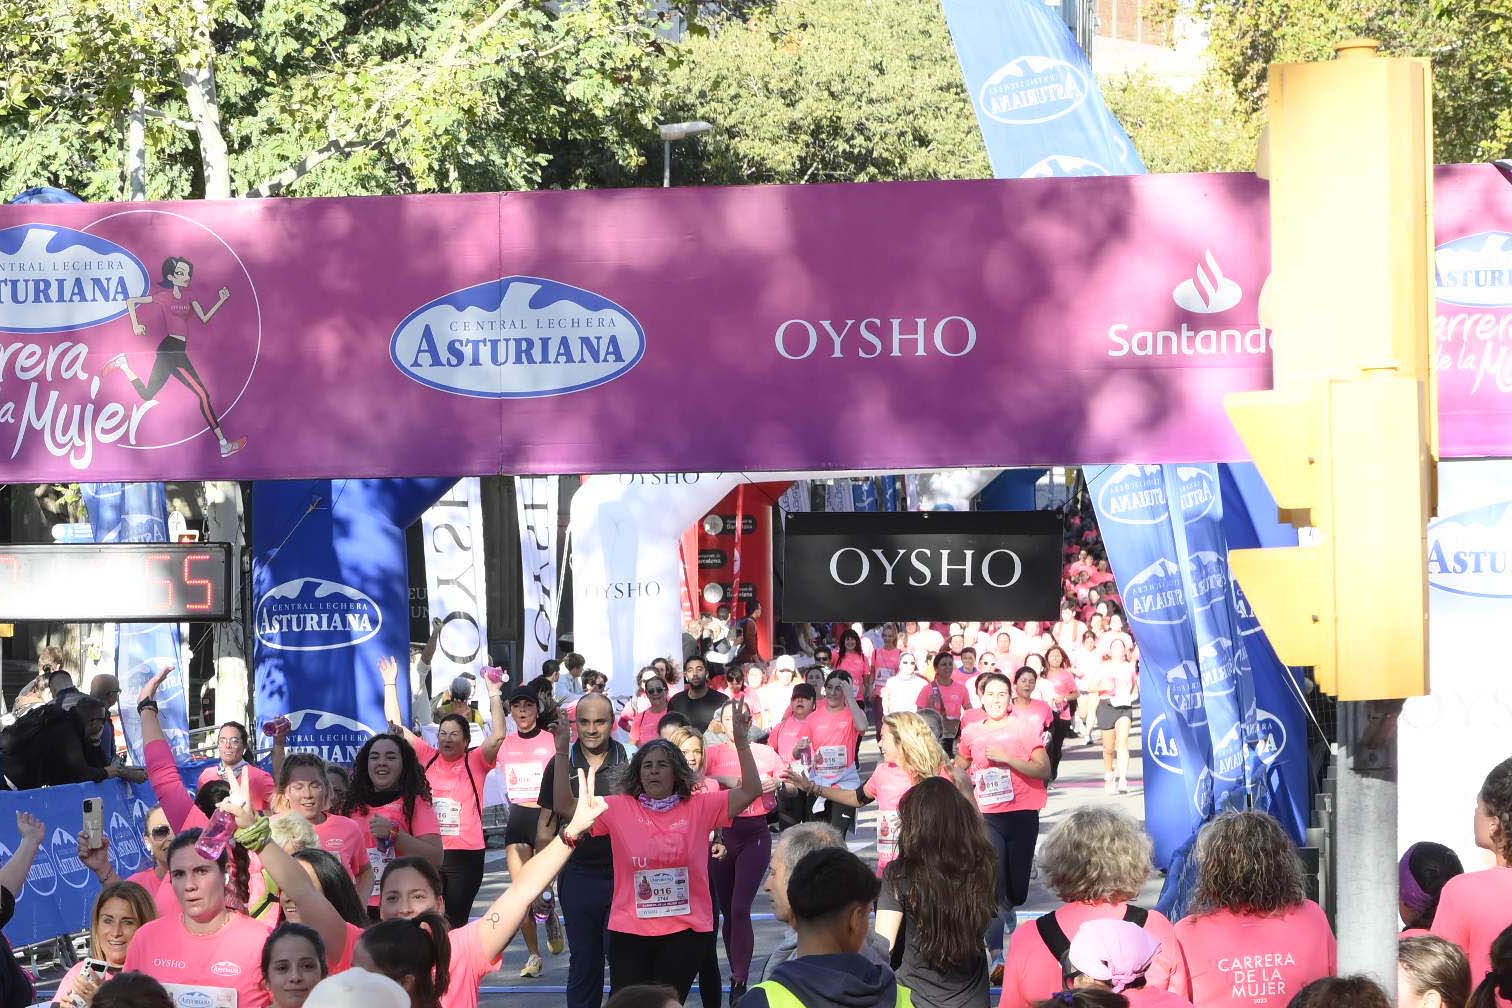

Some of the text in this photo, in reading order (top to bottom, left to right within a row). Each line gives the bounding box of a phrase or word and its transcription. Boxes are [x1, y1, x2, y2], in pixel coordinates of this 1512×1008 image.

[53, 260, 125, 271] LECHERA
[449, 316, 617, 332] CENTRAL LECHERA
[410, 323, 626, 368] ASTURIANA
[775, 315, 977, 360] OYSHO
[1107, 323, 1274, 356] Santand
[9, 381, 160, 470] Mujer
[829, 547, 1022, 588] OYSHO
[272, 601, 368, 612] CENTRAL LECHERA
[259, 607, 373, 636] ASTURIANA
[319, 733, 368, 742] LECHERA
[631, 856, 647, 868] TU
[653, 887, 672, 897] 016
[153, 958, 186, 970] OYSHO
[1217, 952, 1296, 973] CARRERA
[1233, 967, 1283, 984] DE LA
[1231, 981, 1286, 998] MUJER
